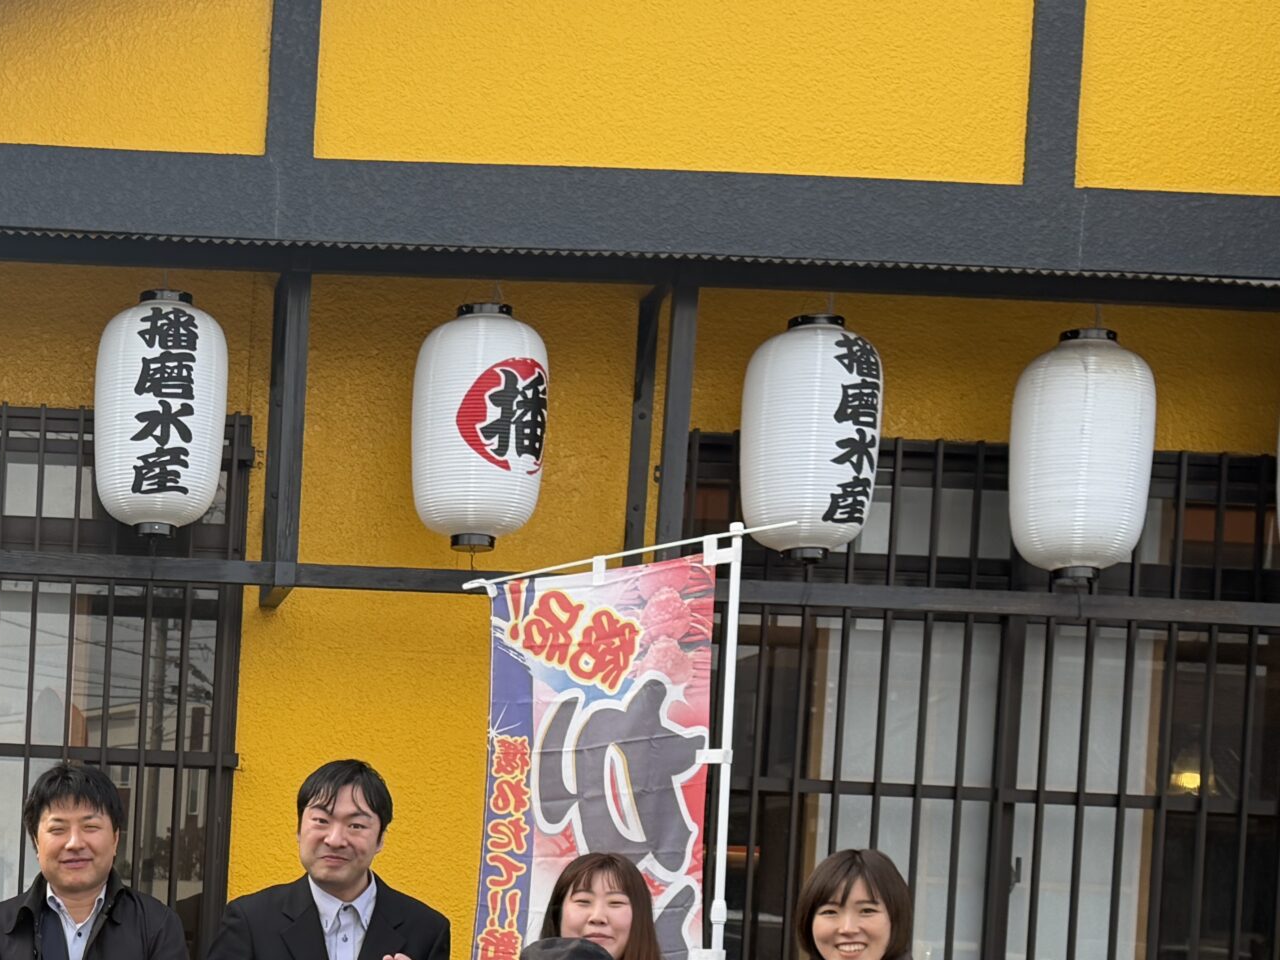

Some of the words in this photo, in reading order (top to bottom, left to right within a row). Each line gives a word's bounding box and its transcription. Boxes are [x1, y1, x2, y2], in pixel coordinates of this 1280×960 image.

[129, 306, 199, 495] 播磨水産
[479, 367, 547, 461] 播
[821, 333, 880, 525] 播磨水産
